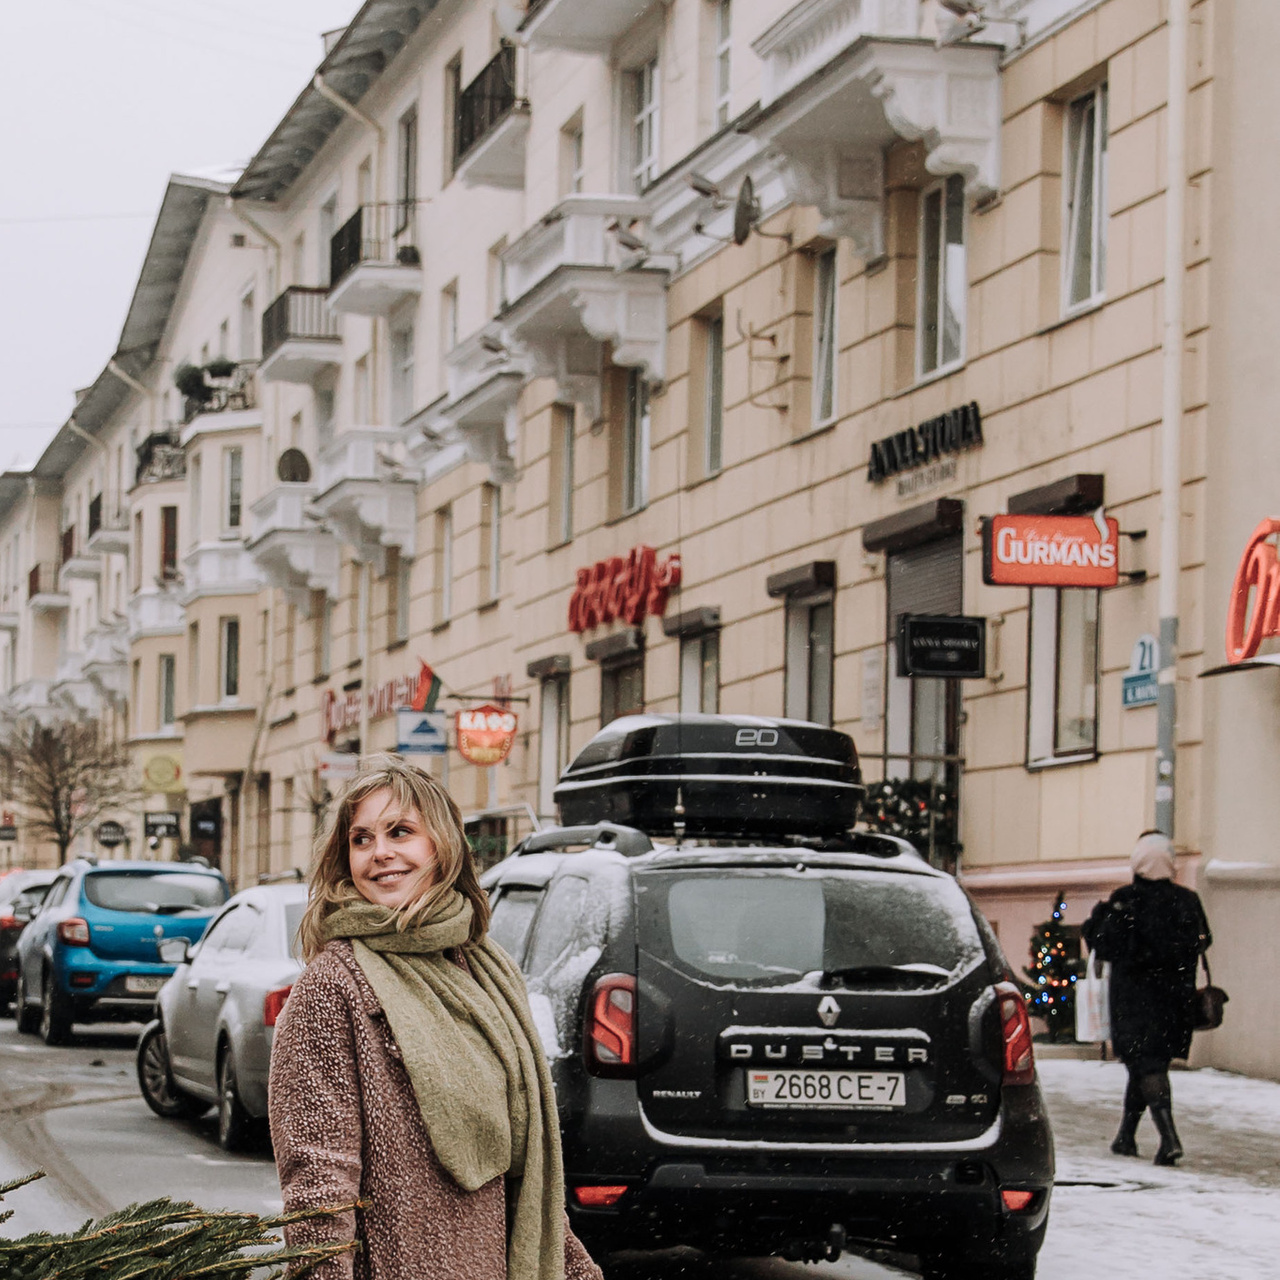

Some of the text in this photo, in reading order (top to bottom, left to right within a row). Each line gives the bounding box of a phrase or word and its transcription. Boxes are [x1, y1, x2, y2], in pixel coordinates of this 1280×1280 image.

[1139, 641, 1153, 671] 21
[730, 1044, 929, 1063] DUSTER
[652, 1090, 702, 1098] RENAULT
[753, 1088, 766, 1099] BY
[773, 1074, 832, 1100] 2668
